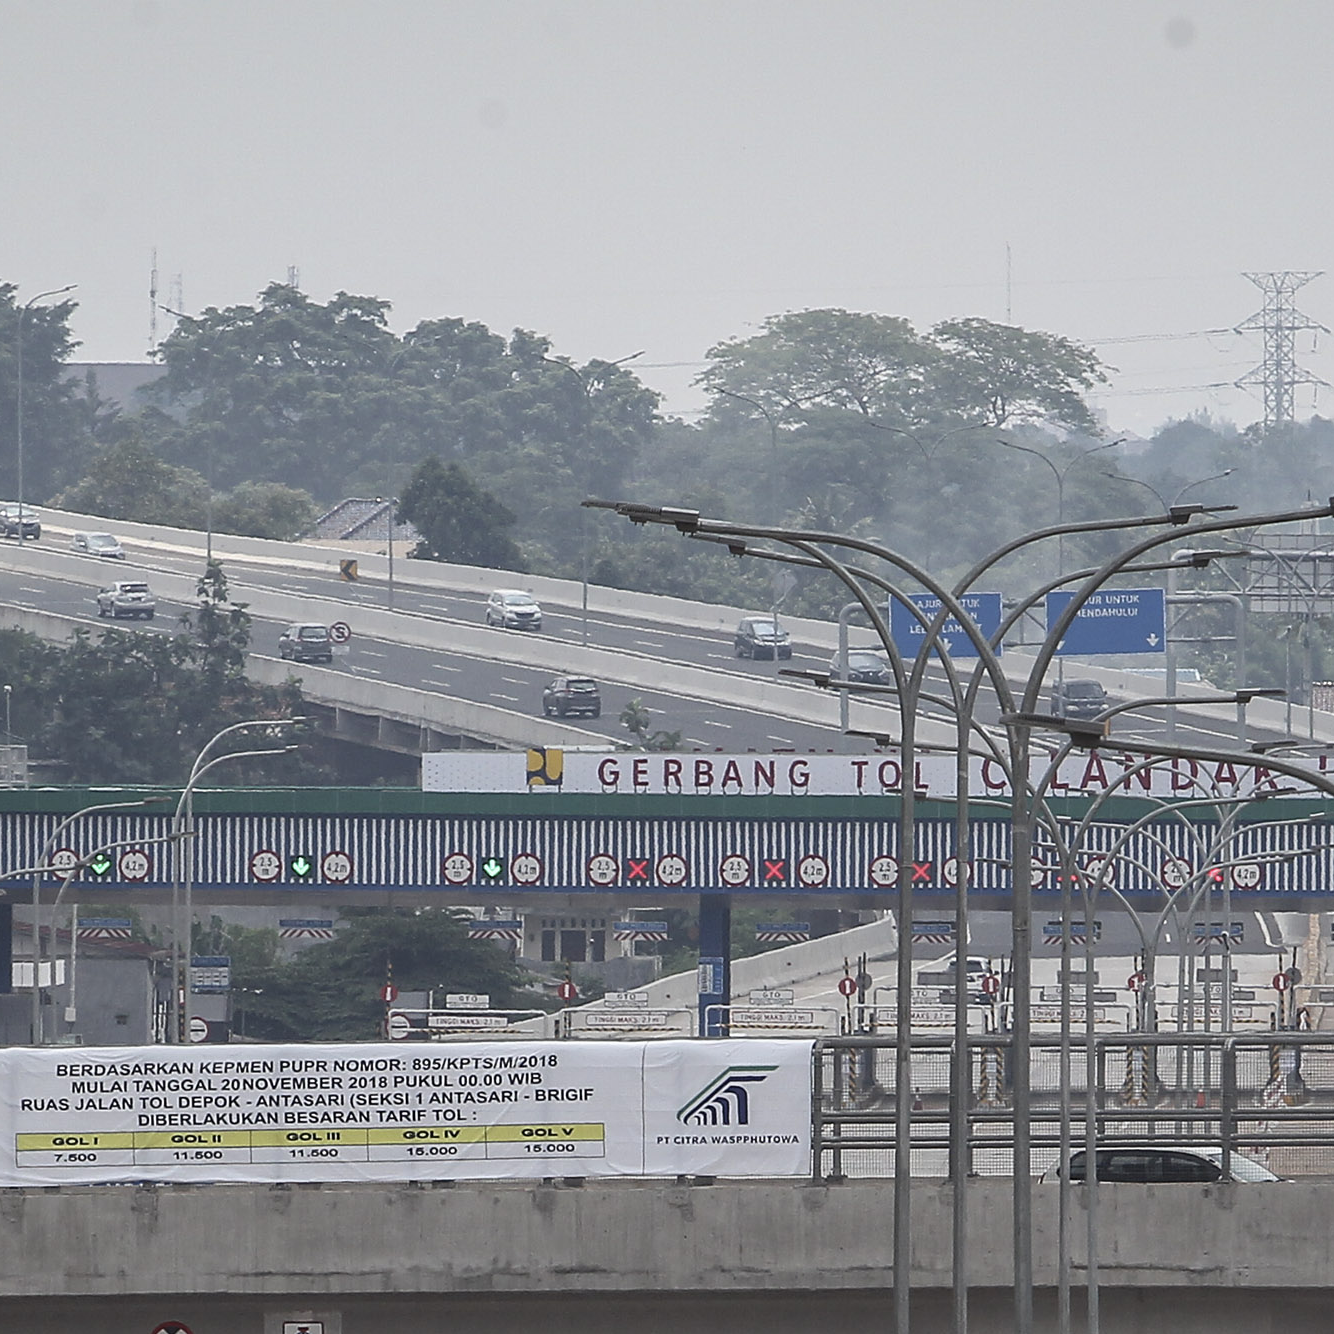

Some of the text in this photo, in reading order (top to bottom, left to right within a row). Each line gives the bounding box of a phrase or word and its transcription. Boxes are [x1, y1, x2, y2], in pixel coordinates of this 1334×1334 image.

[1105, 595, 1140, 604] UNTUK
[941, 624, 983, 633] LAMT
[598, 758, 811, 789] GERBANG
[851, 760, 929, 790] TOL
[981, 748, 1279, 791] CLANDAK
[56, 1055, 558, 1077] BERDASARKAN KEPMEN PUPR NOMOR: 895/KPTS/M/2018
[71, 1081, 128, 1094] MULAI
[133, 1079, 218, 1093] TANGGAL
[348, 1076, 388, 1089] 2018
[393, 1074, 454, 1088] PUKUL
[458, 1074, 502, 1086] 00.00
[508, 1072, 543, 1085] WIB
[21, 1099, 69, 1111] RUAS
[74, 1098, 134, 1111] JALAN
[139, 1097, 174, 1110] TOL
[178, 1096, 241, 1109] DEPOK
[255, 1094, 345, 1108] ANTASARI
[350, 1093, 409, 1109] (SEKSI
[416, 1093, 423, 1104] 1
[428, 1090, 518, 1105] ANTASARI
[535, 1088, 594, 1102] BRIGIF
[138, 1112, 279, 1127] DIBERLAKUKAN
[284, 1110, 370, 1124] BESARAN
[376, 1109, 427, 1123] TARIF
[432, 1108, 468, 1121] TOL
[286, 1132, 341, 1142] GOL III
[403, 1129, 461, 1140] GOL IV
[521, 1128, 575, 1138] GOL V
[52, 1137, 98, 1146] GOL I
[171, 1134, 221, 1144] GOL II
[656, 1135, 800, 1144] PT CITRA WASPPHUTOWA
[289, 1148, 339, 1158] 11.500
[407, 1146, 458, 1156] 15.000
[524, 1143, 575, 1153] 15.000
[54, 1153, 97, 1162] 7.500
[173, 1151, 223, 1160] 11.500
